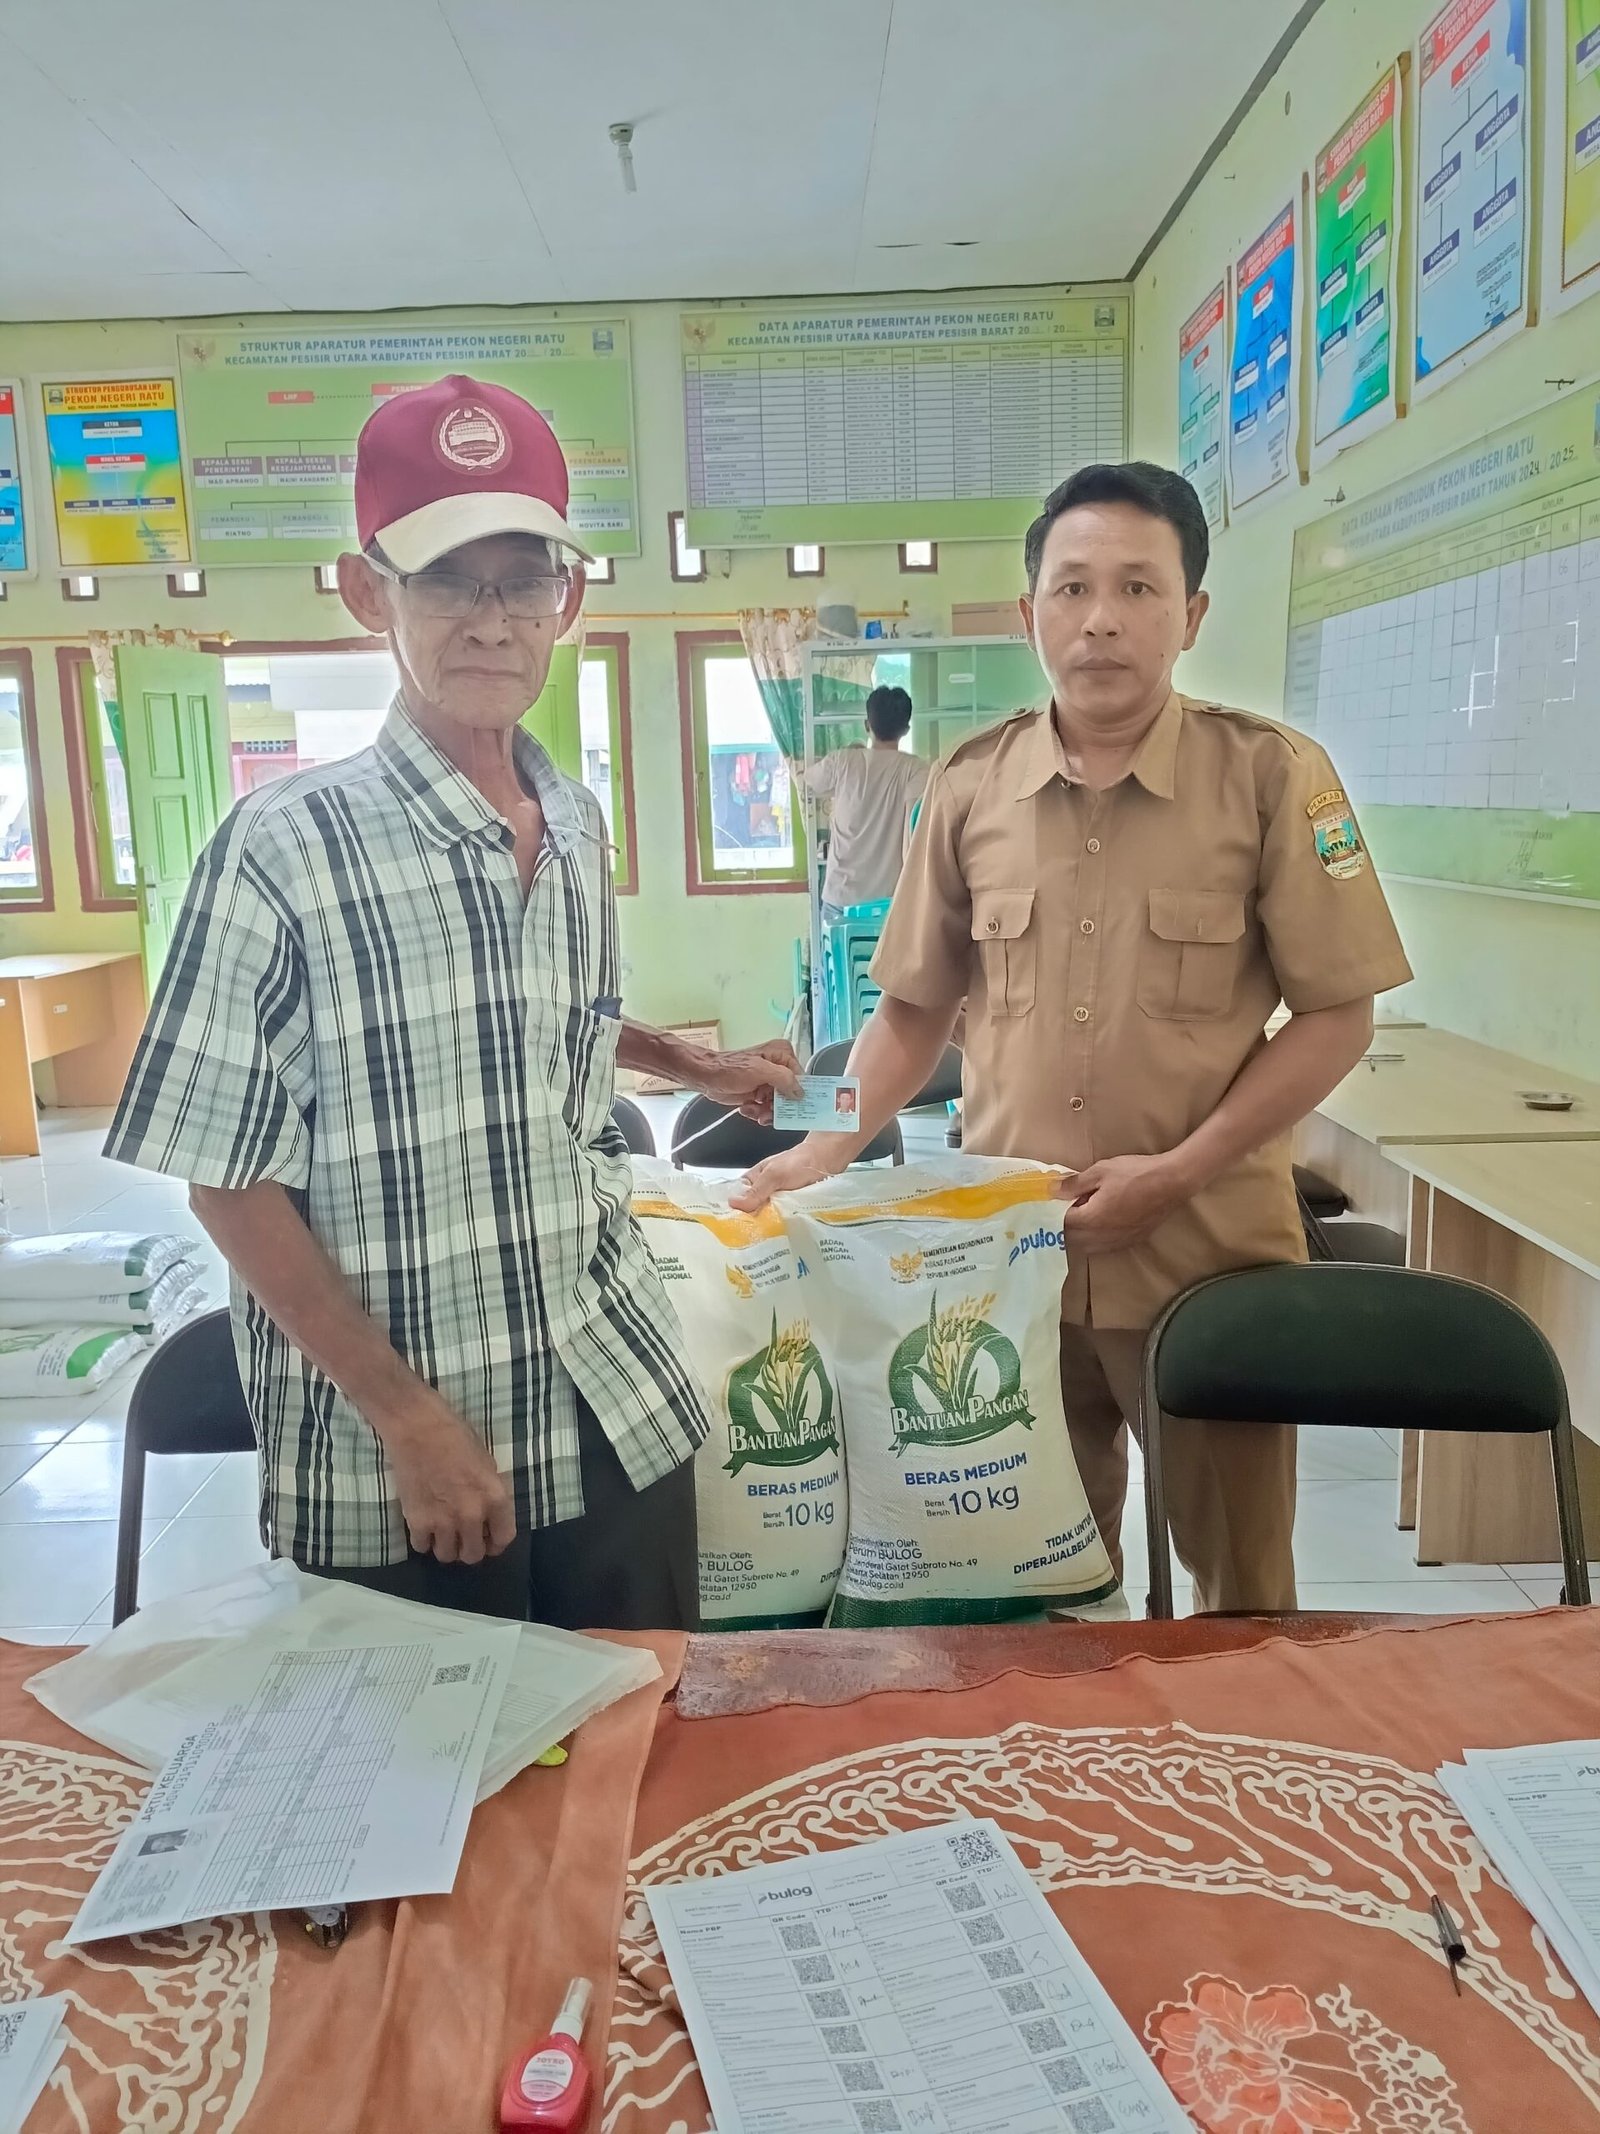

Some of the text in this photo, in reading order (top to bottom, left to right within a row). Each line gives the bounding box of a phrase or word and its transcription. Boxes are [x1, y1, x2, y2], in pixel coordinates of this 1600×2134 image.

[759, 311, 1053, 332] DATA APARATUR PEMERINTAH PEKON NEGERI RATU
[240, 333, 565, 352] STRUKTUR APARATUR PEMERINTAH PEKON NEGERI RATU
[728, 335, 790, 346] KECAMATAN
[794, 334, 833, 344] PESISIR
[836, 333, 870, 342] UTARA
[874, 330, 935, 341] KABUPATEN
[938, 328, 977, 338] PESISIR
[981, 326, 1014, 336] BARAT
[225, 355, 288, 365] KECAMATAN
[291, 353, 331, 363] PESISIR
[334, 353, 367, 362] UTARA
[371, 351, 432, 362] KABUPATEN
[436, 350, 475, 360] PESISIR
[478, 348, 510, 359] BARAT
[64, 391, 165, 405] PEKON NEGERI RATU
[1394, 486, 1436, 516] PENDUDUK
[1438, 468, 1467, 491] PEKON
[1468, 452, 1504, 481] NEGERI
[1506, 436, 1535, 461] RATU
[1460, 483, 1487, 506] BARAT
[1488, 469, 1517, 495] TAHUN
[1309, 791, 1340, 812] PEMKAB
[819, 1239, 844, 1247] BADAN
[662, 1272, 692, 1280] ASIONAL
[891, 1389, 1029, 1435] BANTUAN PANGAN
[728, 1416, 836, 1453] BANTUAN PANGAN
[904, 1452, 1027, 1485] BERAS MEDIUM
[747, 1471, 839, 1496] BERAS MEDIUM
[924, 1485, 1019, 1515] Berat 10 kg
[763, 1501, 834, 1527] Berat 10 kg
[926, 1509, 951, 1517] Bersih
[1045, 1529, 1074, 1549] TIDAK
[878, 1548, 922, 1560] BULOG
[707, 1560, 754, 1571] BULOG
[885, 1562, 909, 1571] Gatot
[911, 1560, 947, 1570] Subroto
[949, 1560, 963, 1568] No.
[966, 1558, 978, 1567] 49
[714, 1574, 739, 1583] Gatot
[790, 1569, 800, 1577] 49
[869, 1569, 930, 1580] Selatan 12950
[700, 1582, 757, 1592] elatan 12950
[141, 1791, 166, 1823] ARTU
[159, 1733, 198, 1790] KELUARGA
[949, 1874, 968, 1883] Code
[767, 1884, 813, 1902] bulog
[848, 1898, 871, 1908] Nama
[786, 1913, 806, 1922] Code
[680, 1927, 703, 1935] Nama
